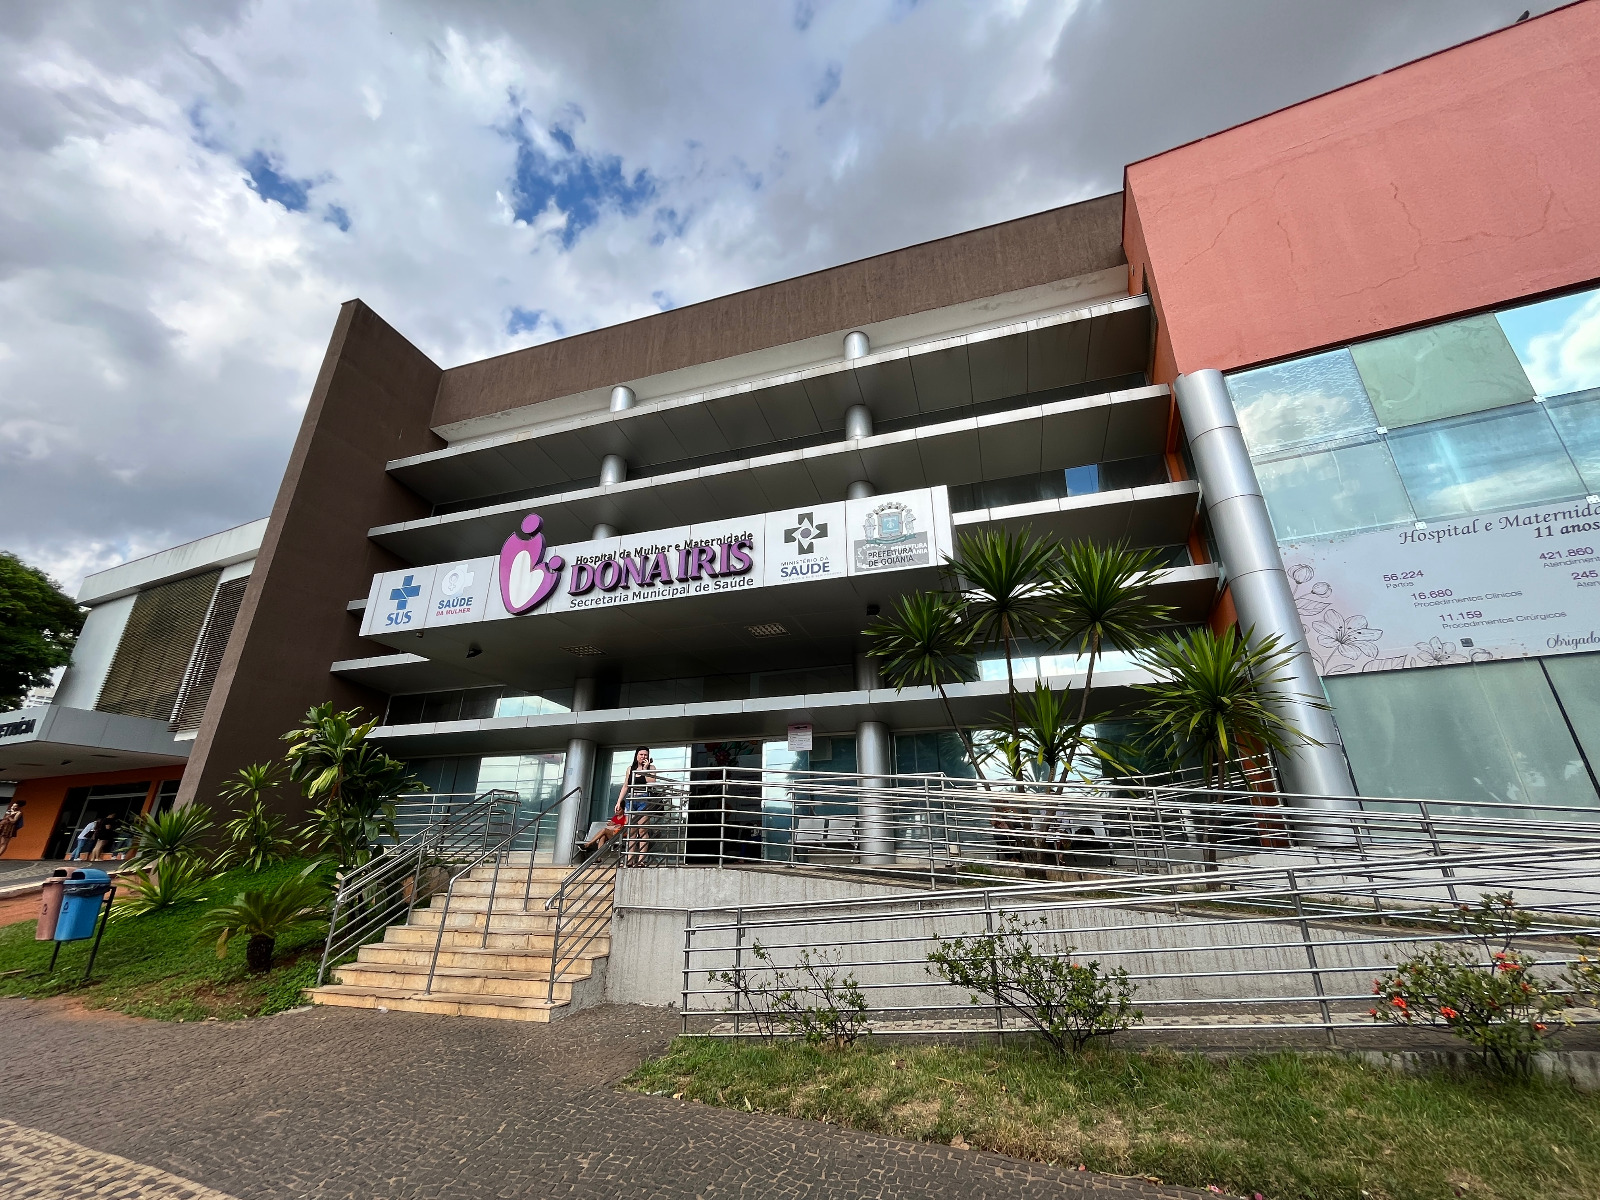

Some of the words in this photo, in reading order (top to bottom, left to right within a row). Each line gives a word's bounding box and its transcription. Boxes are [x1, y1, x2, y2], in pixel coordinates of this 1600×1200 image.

[1399, 519, 1479, 544] Hospital
[1485, 522, 1493, 532] e
[1534, 525, 1554, 538] 11
[1561, 521, 1600, 534] anos
[576, 551, 617, 565] Hospital
[620, 549, 631, 559] da
[634, 544, 672, 558] Mulher
[684, 531, 753, 550] Maternidade
[868, 547, 914, 559] PREFEITURA
[1539, 546, 1594, 560] 421.860
[568, 550, 674, 597] DONA
[675, 540, 753, 582] IRIS
[1383, 570, 1424, 582] 56.224
[570, 592, 629, 608] Secretaria
[632, 584, 690, 600] Municipal
[695, 582, 710, 593] de
[714, 576, 754, 590] Saúde
[1411, 589, 1453, 600] 16.680
[438, 597, 473, 610] SAÚDE
[385, 611, 413, 627] SUS
[1439, 610, 1482, 622] 11.159
